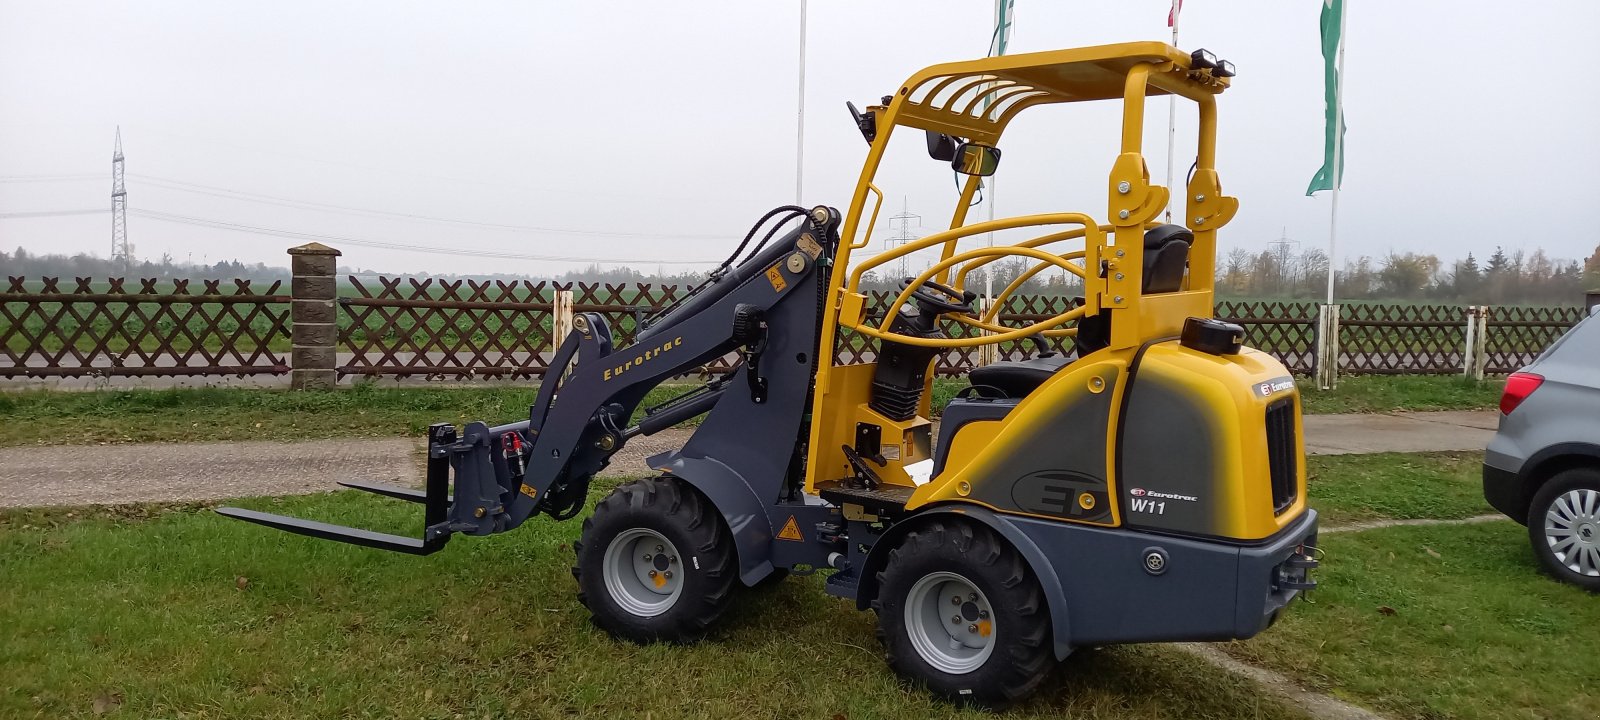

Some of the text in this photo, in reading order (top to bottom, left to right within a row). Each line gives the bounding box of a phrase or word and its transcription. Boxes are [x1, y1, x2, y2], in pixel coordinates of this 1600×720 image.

[603, 336, 682, 381] Eurotrac
[1147, 490, 1198, 502] Eurotrac
[1131, 498, 1166, 515] W11
